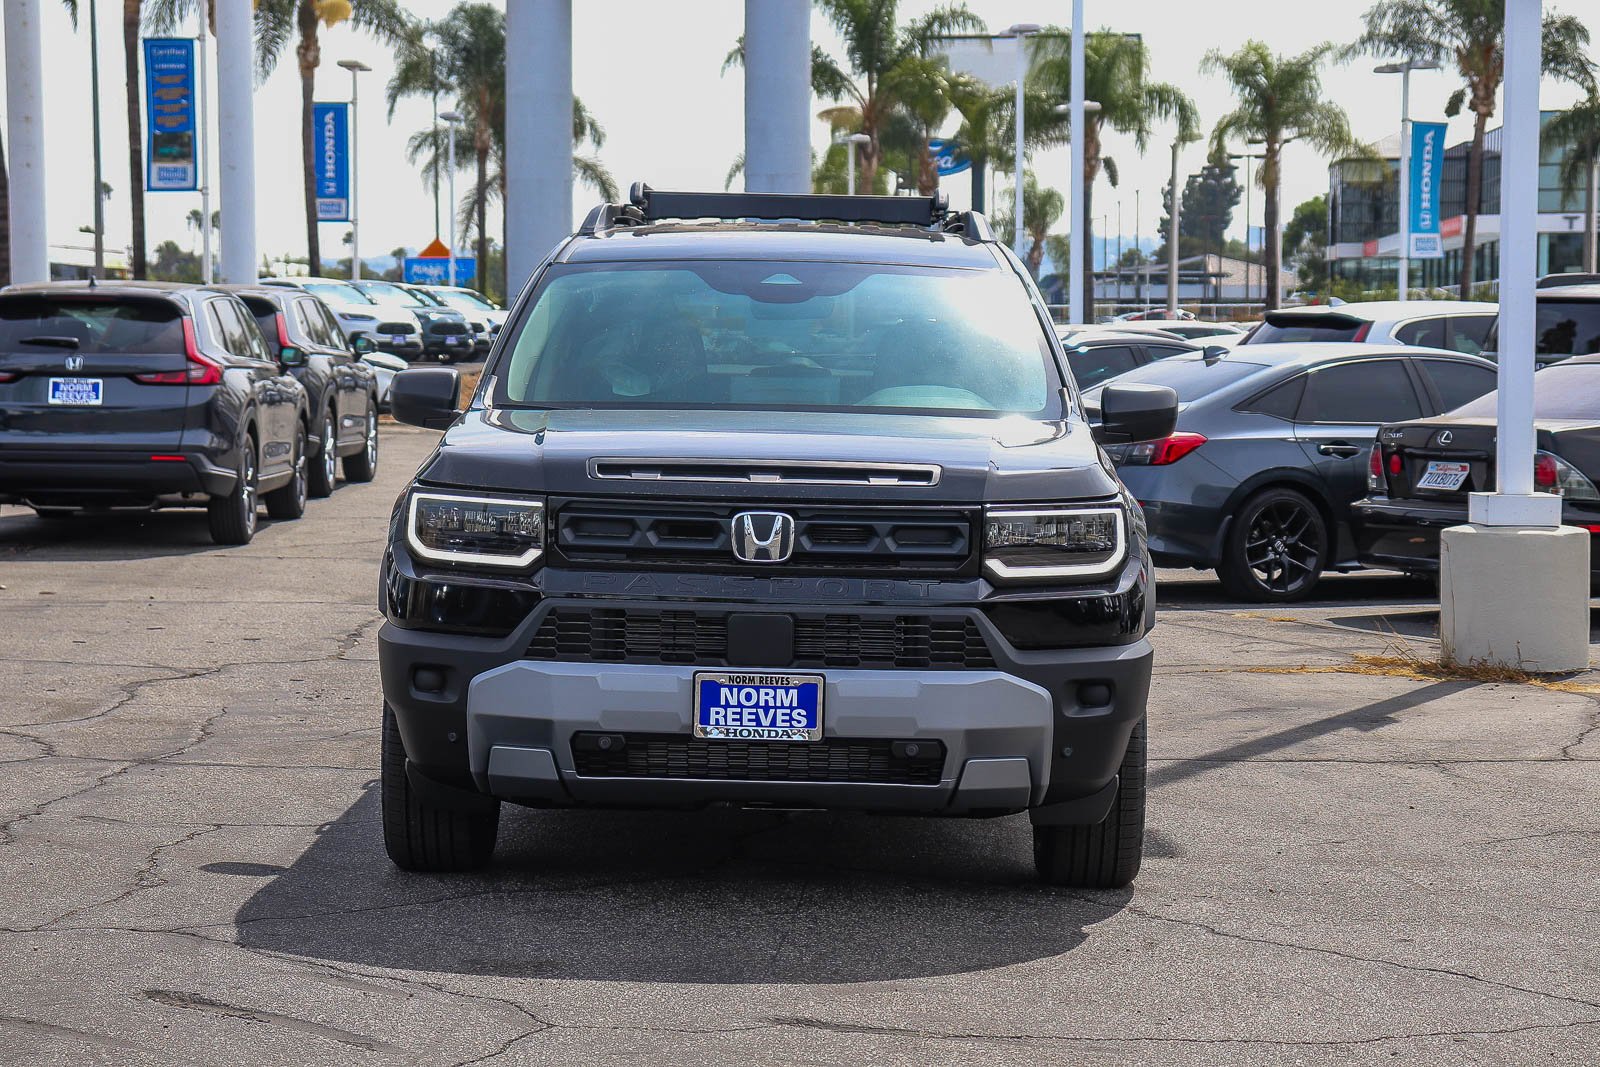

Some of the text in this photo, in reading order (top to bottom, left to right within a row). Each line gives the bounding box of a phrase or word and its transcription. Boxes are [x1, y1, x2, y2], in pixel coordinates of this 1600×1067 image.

[324, 111, 336, 179] HONDA
[1421, 130, 1435, 209] HONDA
[583, 572, 943, 598] PASSPORT
[728, 675, 790, 686] NORM REEVES
[720, 687, 798, 707] NORM
[709, 707, 807, 727] REEVES
[724, 727, 793, 739] HONDA
